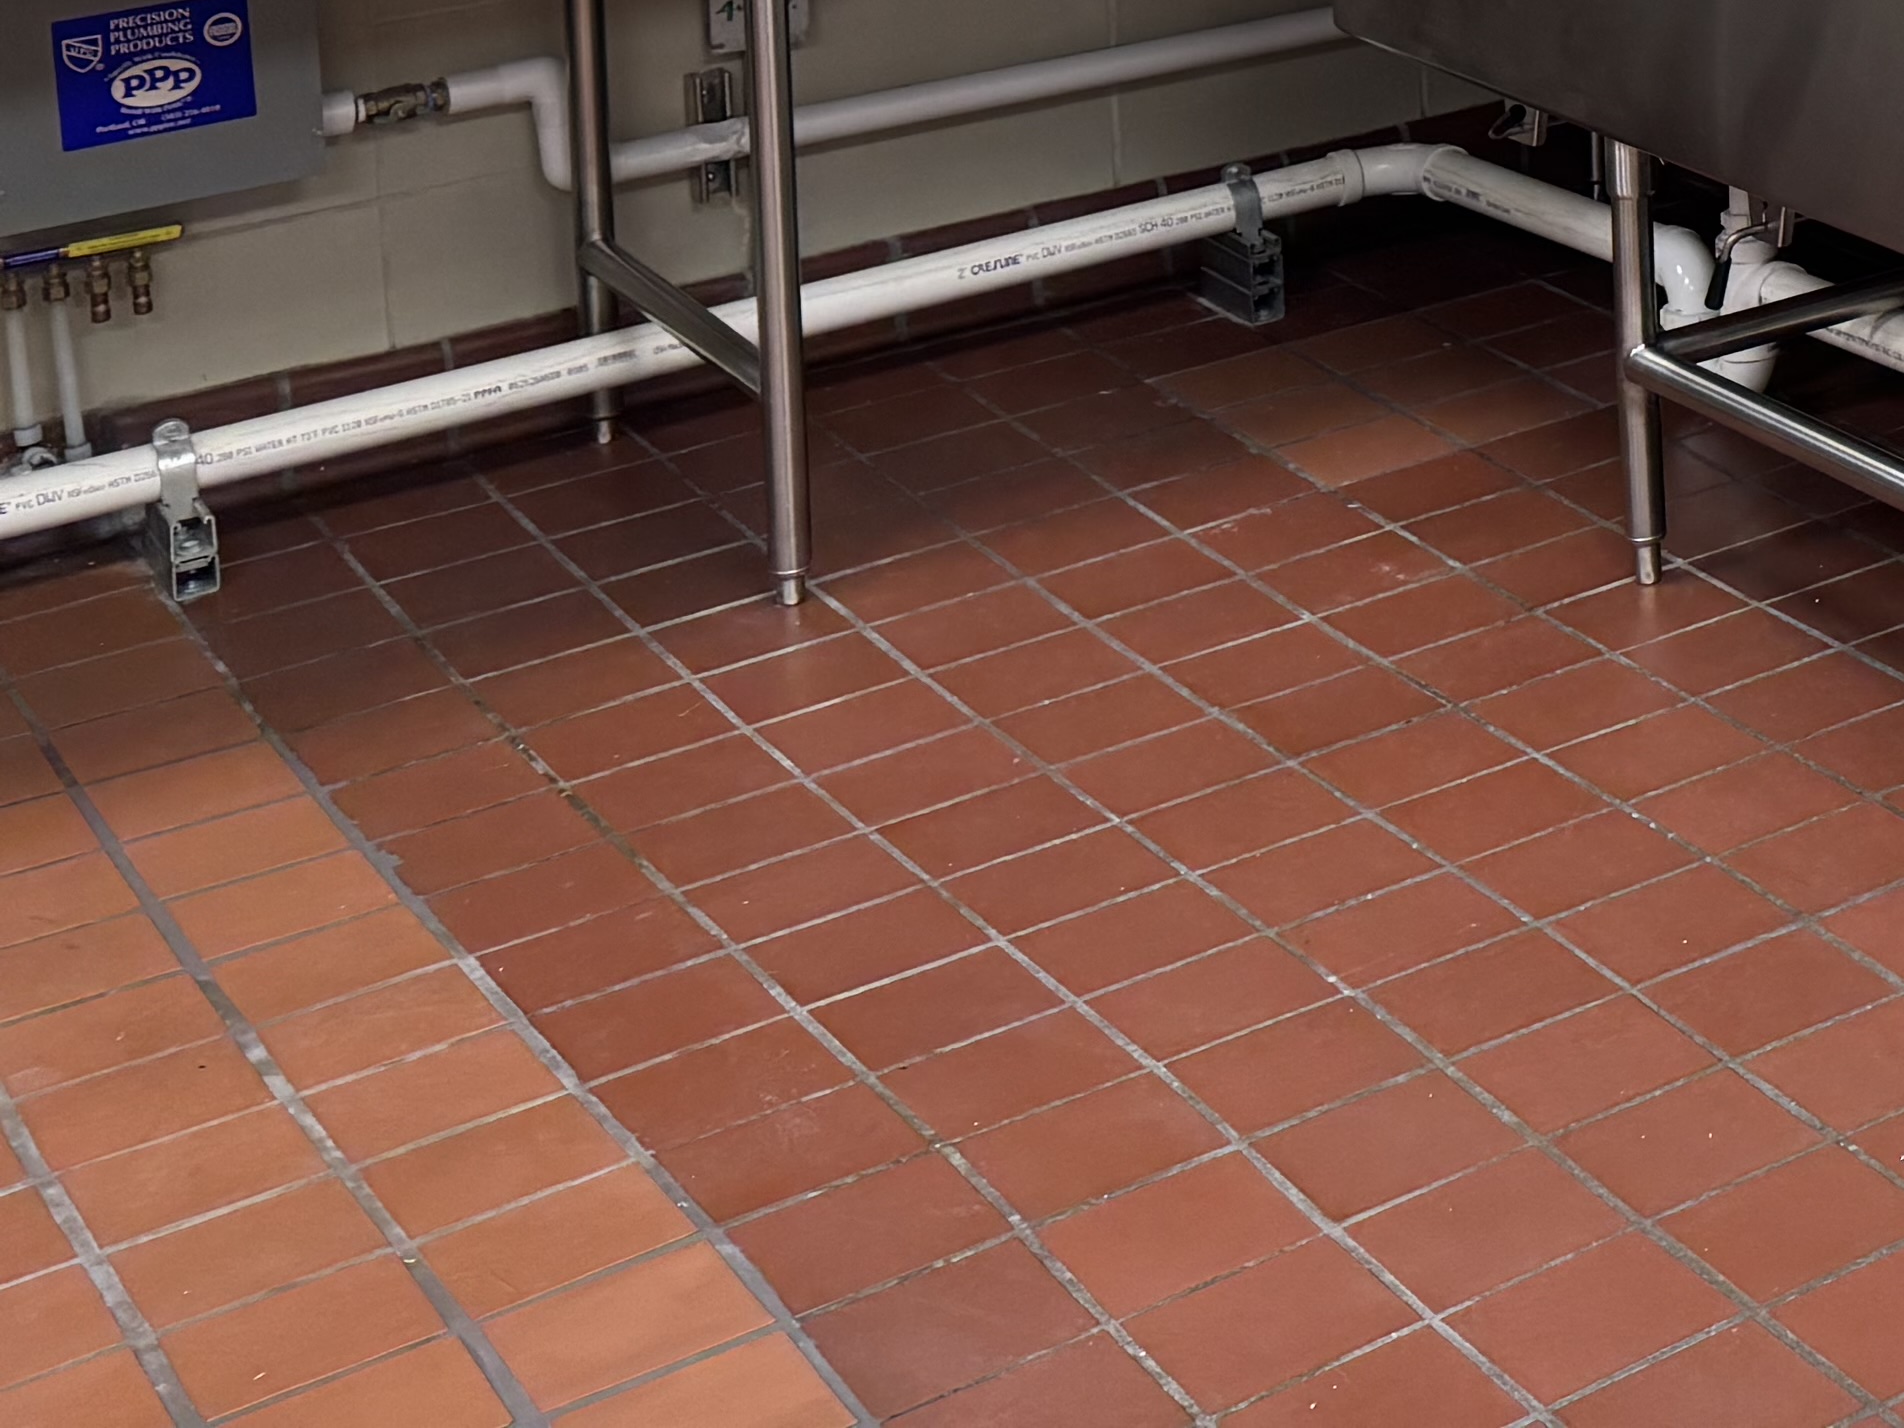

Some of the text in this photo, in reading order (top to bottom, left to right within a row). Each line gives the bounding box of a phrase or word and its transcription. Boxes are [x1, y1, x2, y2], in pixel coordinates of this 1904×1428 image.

[109, 7, 191, 30] PRECISION
[109, 19, 193, 43] PLUMBING
[110, 31, 194, 56] PRODUCTS
[119, 65, 197, 100] PPP
[36, 489, 65, 507] DWV
